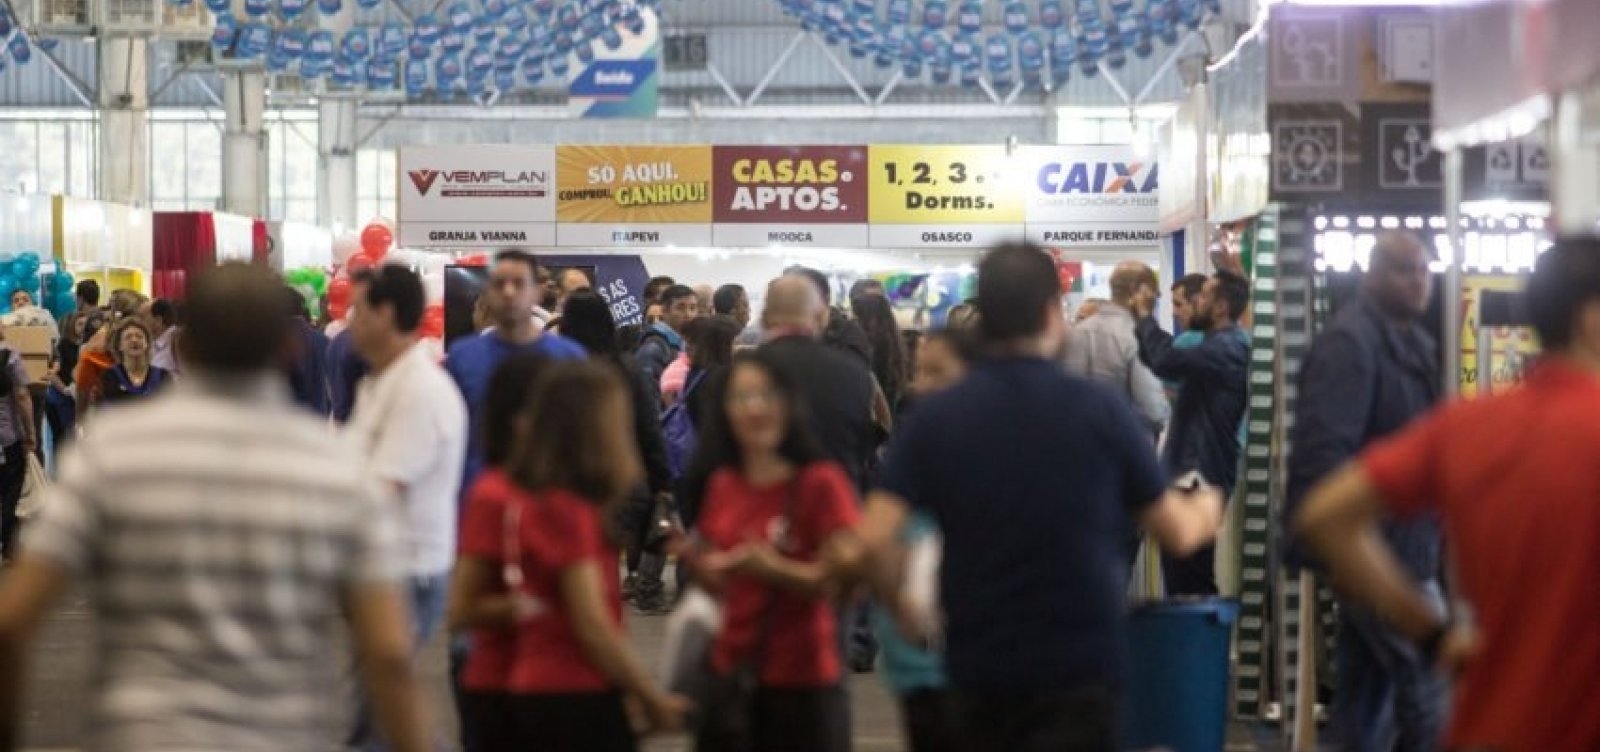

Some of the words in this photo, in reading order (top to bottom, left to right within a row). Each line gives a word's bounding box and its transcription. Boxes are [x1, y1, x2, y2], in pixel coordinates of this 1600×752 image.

[441, 171, 545, 183] VEMPLAN
[732, 158, 839, 184] CASAS
[884, 162, 903, 186] 1,
[912, 162, 937, 186] 2,
[948, 162, 967, 184] 3
[1036, 162, 1159, 194] CAIXA
[614, 182, 706, 206] GANHOU!
[730, 186, 848, 211] APTOS.
[905, 191, 994, 210] Dorms.
[428, 231, 478, 241] GRANJA
[481, 231, 527, 241] VIANNA
[612, 231, 660, 242] ITAPEVI
[767, 231, 813, 242] MOOCA
[921, 232, 973, 243] OSASCO
[1043, 231, 1094, 242] PARQUE
